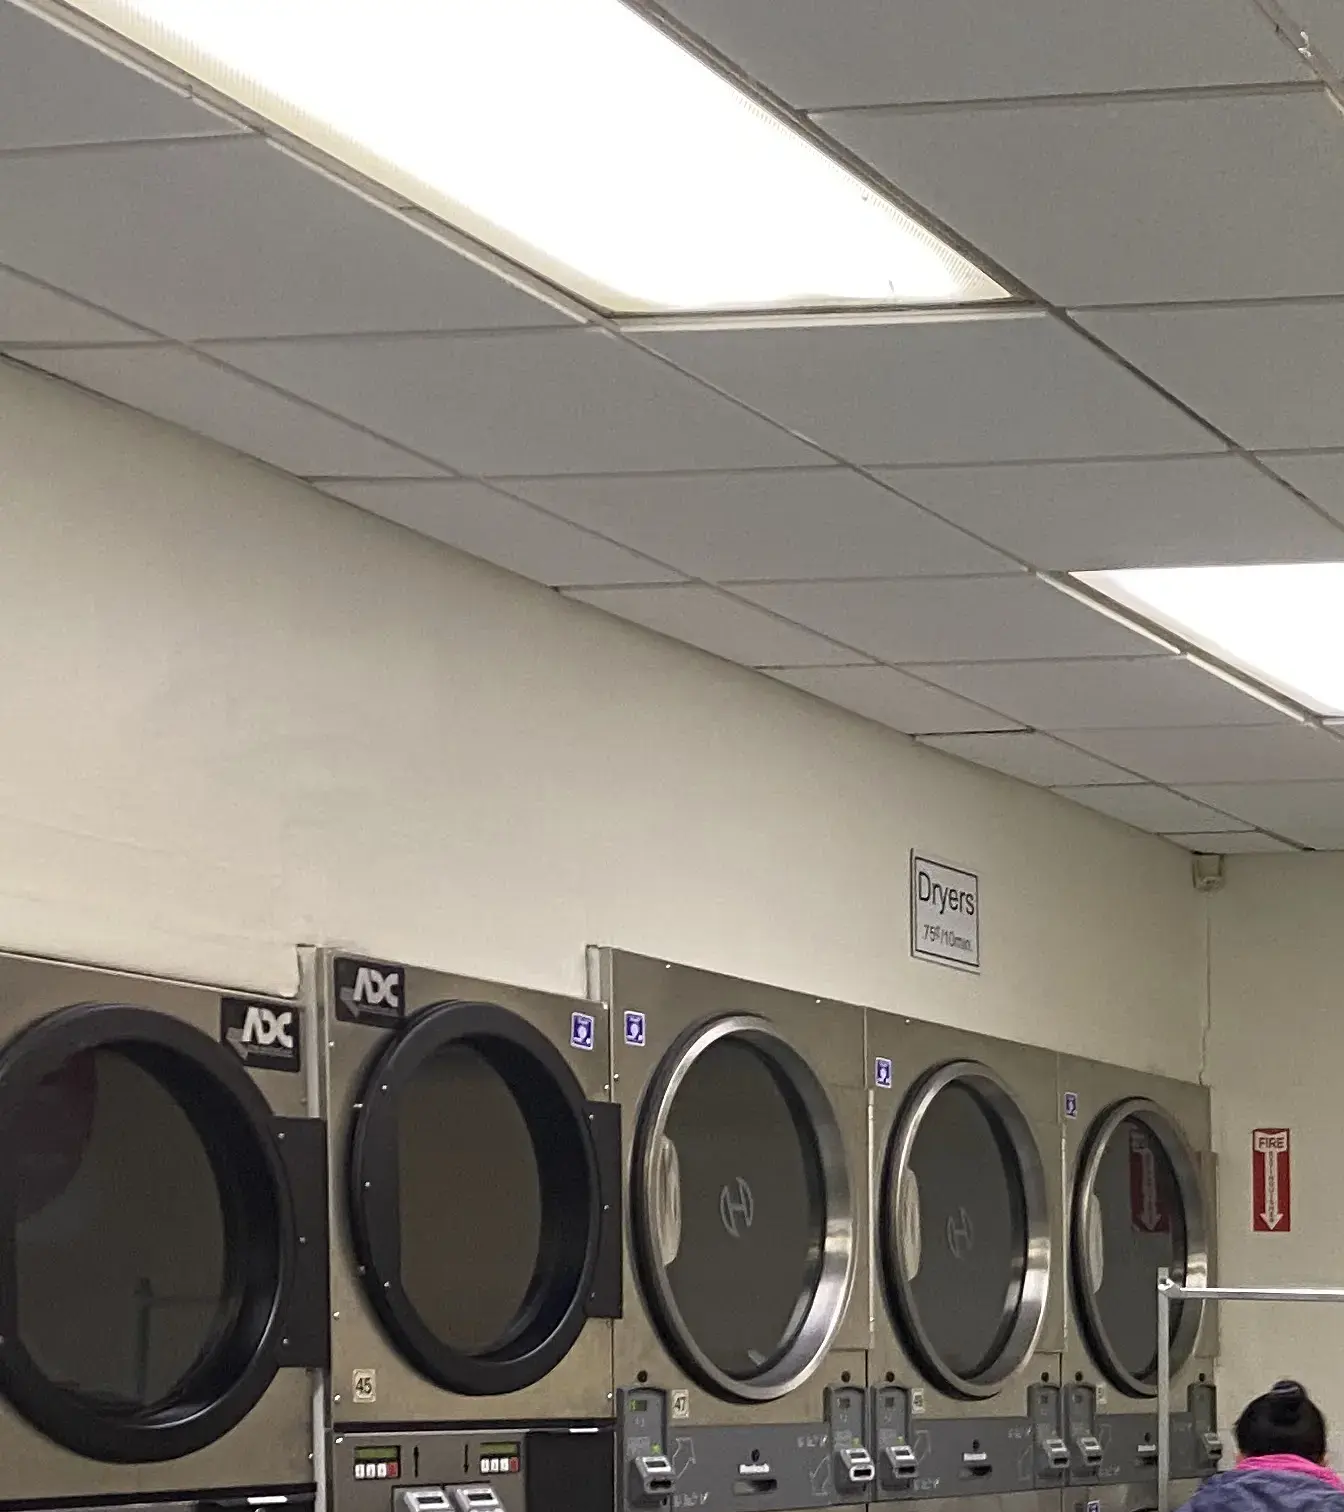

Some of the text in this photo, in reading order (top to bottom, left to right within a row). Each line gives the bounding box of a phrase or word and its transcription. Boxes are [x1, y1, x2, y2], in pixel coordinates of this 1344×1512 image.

[918, 871, 975, 916] Dryers
[1258, 1137, 1285, 1149] FIRE
[355, 1377, 372, 1394] 45
